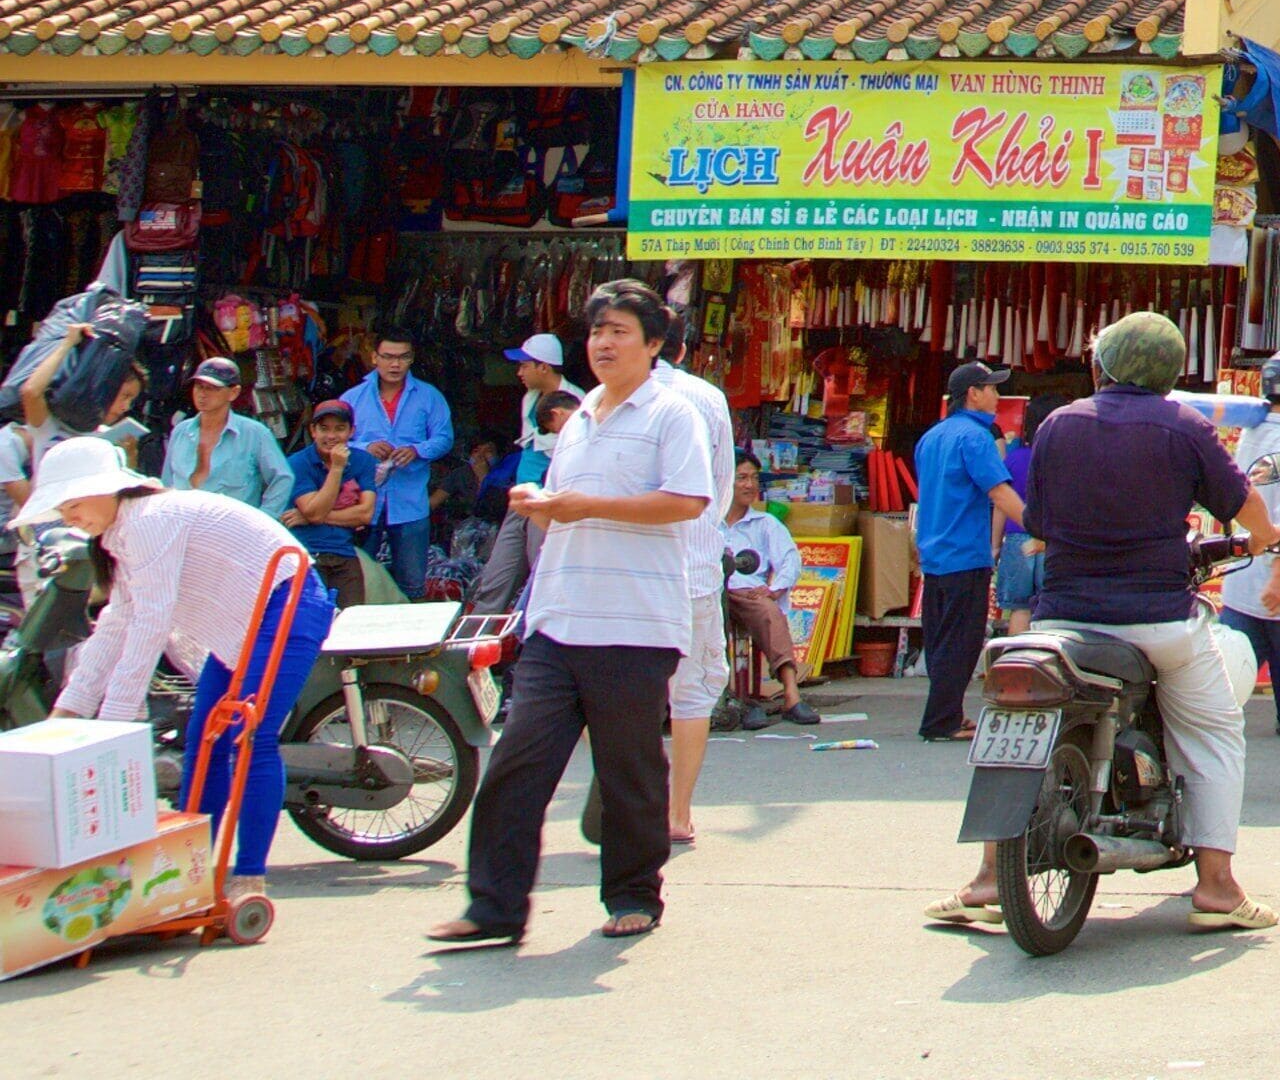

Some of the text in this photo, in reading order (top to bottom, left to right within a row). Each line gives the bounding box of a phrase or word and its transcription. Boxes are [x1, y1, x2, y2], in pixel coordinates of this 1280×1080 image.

[688, 71, 724, 91] CÔNG
[727, 73, 743, 90] TY
[746, 73, 783, 90] TNHH
[785, 68, 812, 91] SẢN
[814, 67, 850, 91] XUẤT
[860, 71, 911, 92] THƯƠNG
[914, 74, 938, 96] MẠI
[991, 70, 1042, 96] HÙNG
[1049, 75, 1105, 100] THỊNH
[694, 97, 785, 119] CỬA HÀNG
[802, 105, 931, 187] Xuân
[951, 105, 1074, 190] Khải
[667, 146, 780, 194] LỊCH
[651, 200, 1190, 232] CHUYÊN BÁN SỈ & LẺ CÁC LOẠI LỊCH NHẬN IN QUẢNG CÁO
[641, 238, 663, 252] 57A
[666, 236, 691, 254] Tháp
